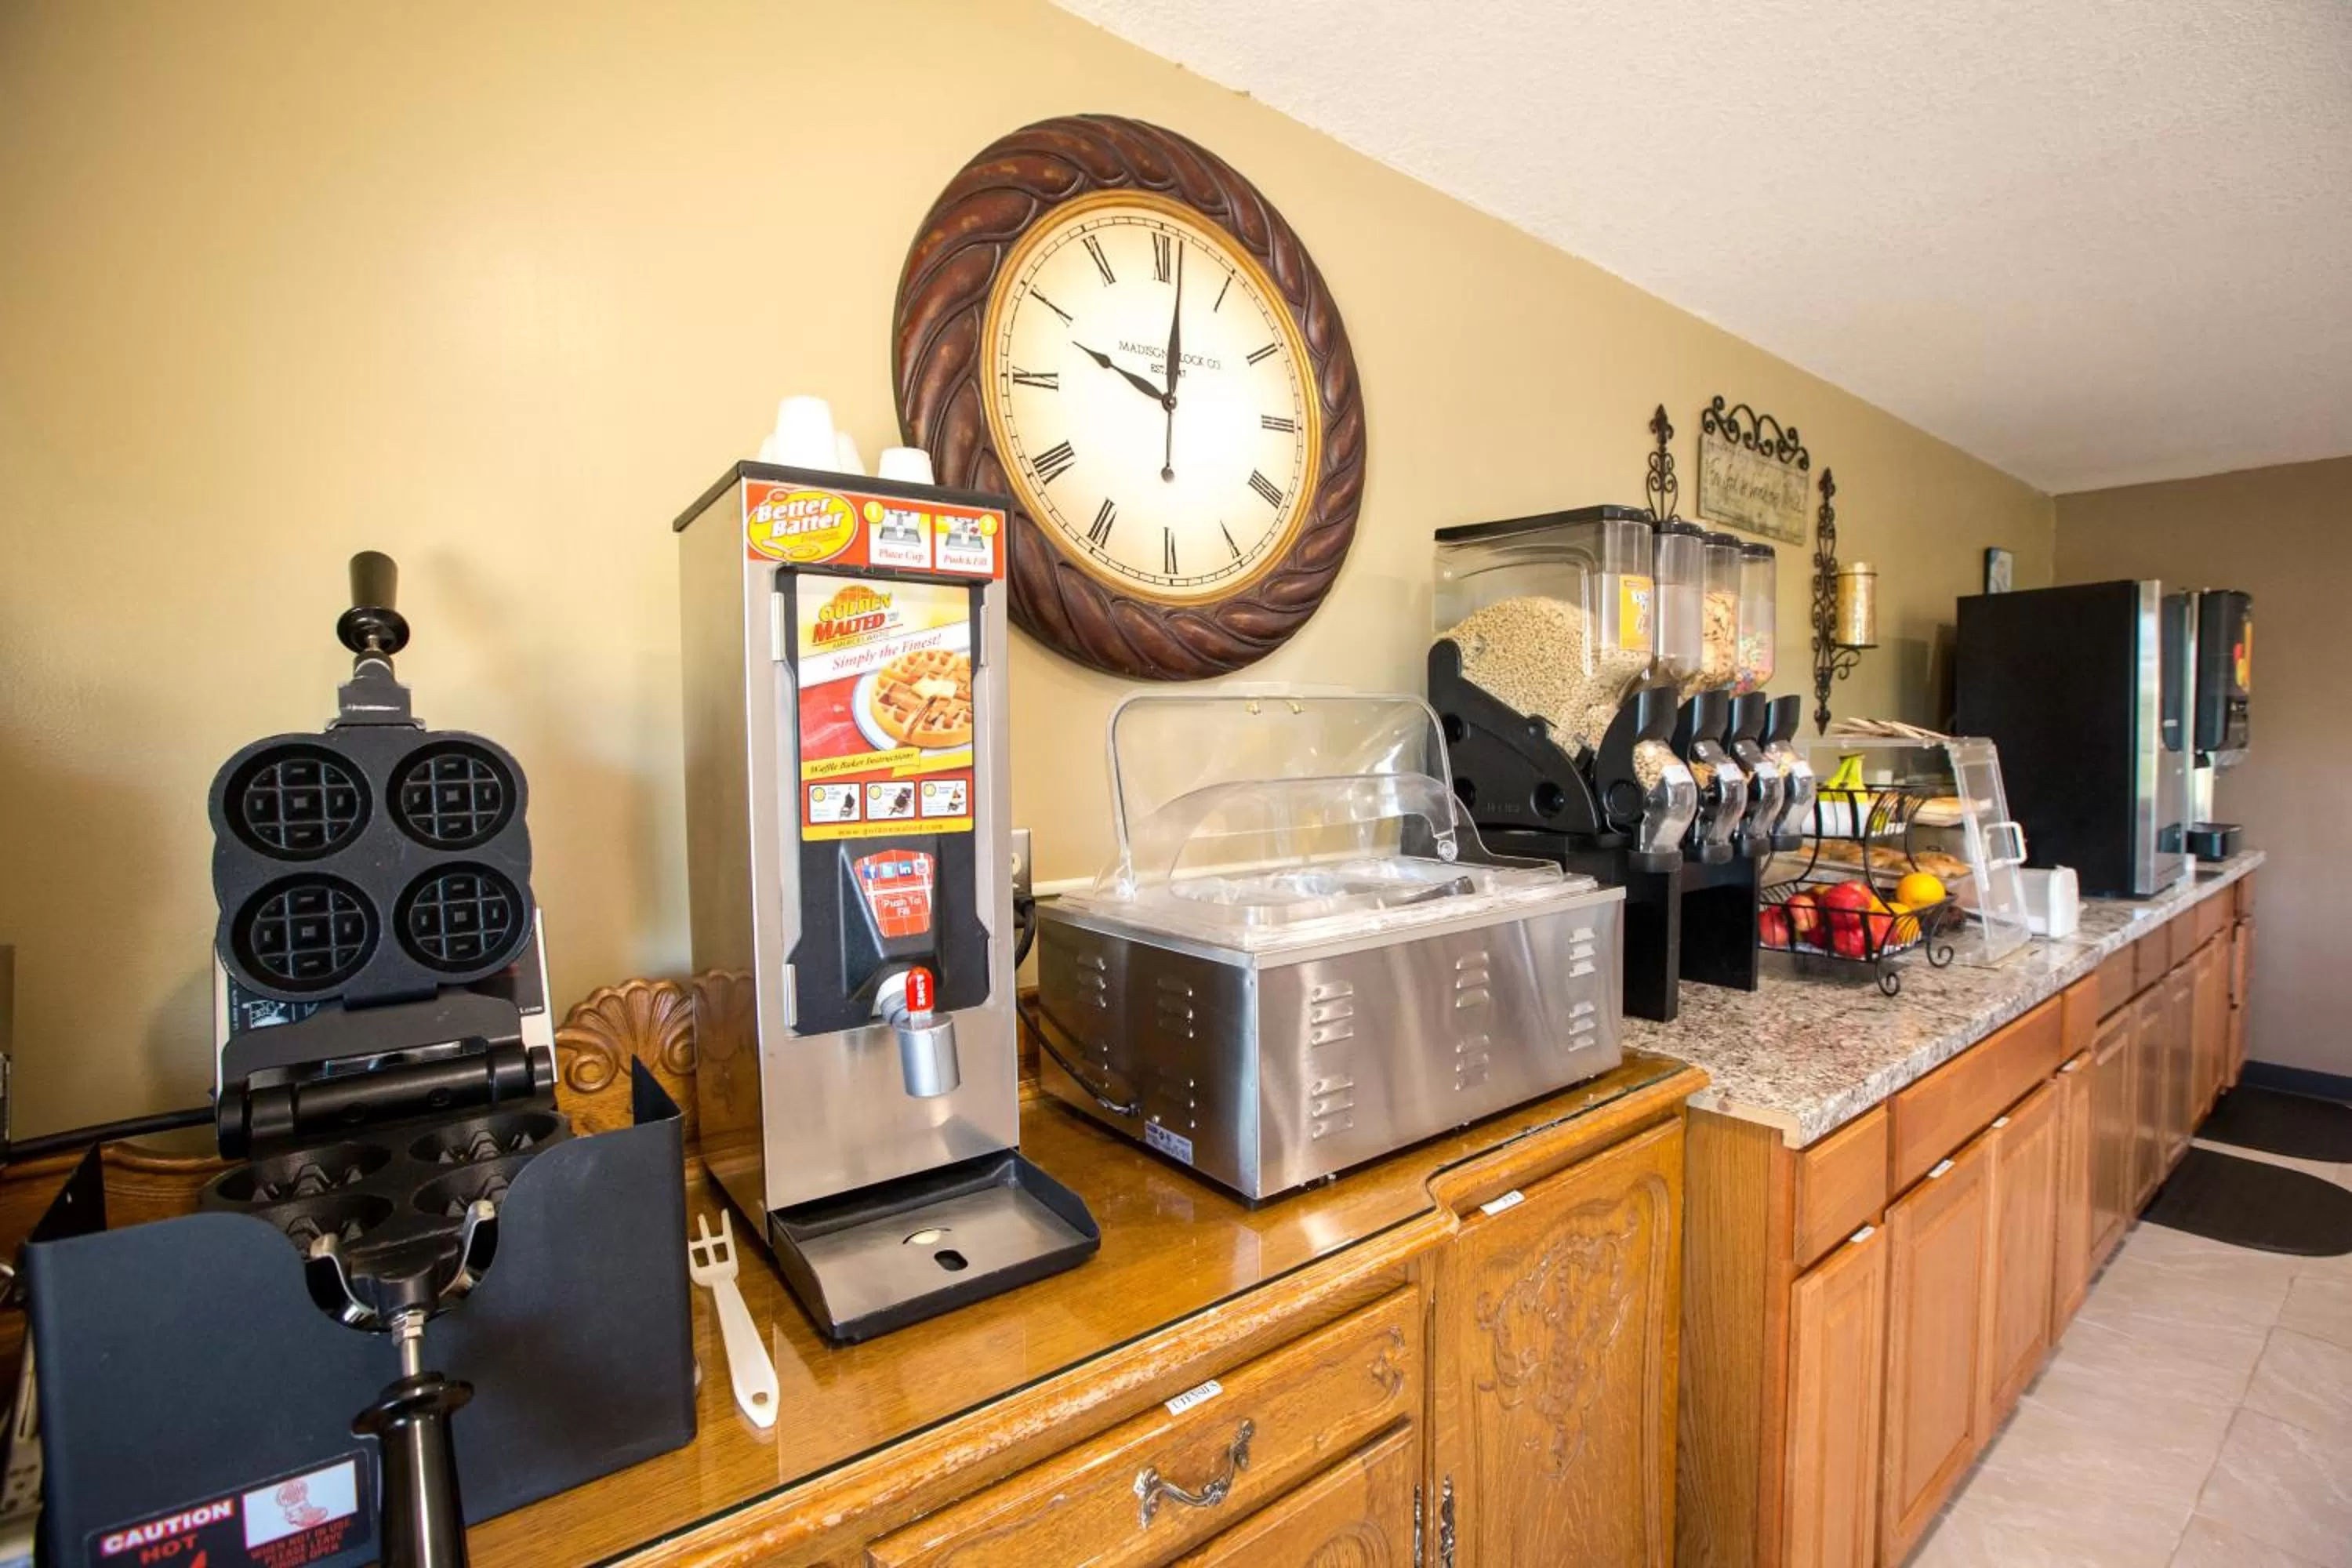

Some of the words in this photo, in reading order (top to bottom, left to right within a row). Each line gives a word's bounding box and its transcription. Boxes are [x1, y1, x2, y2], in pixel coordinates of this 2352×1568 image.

[756, 497, 832, 523] Better
[771, 511, 844, 539] Batter
[878, 548, 904, 560] Place
[906, 549, 925, 564] Cup
[818, 592, 892, 622] GOLDEN
[813, 613, 886, 644] MALTED
[832, 648, 878, 671] Simply
[879, 643, 899, 660] the
[902, 632, 942, 654] Finest!
[810, 760, 839, 775] Waffle
[840, 758, 866, 771] Baker
[866, 751, 914, 766] Instructions
[884, 898, 908, 908] Push
[909, 896, 921, 905] To
[916, 974, 927, 1007] PUSH
[103, 1500, 232, 1554] CAUTION
[138, 1533, 199, 1566] HOT
